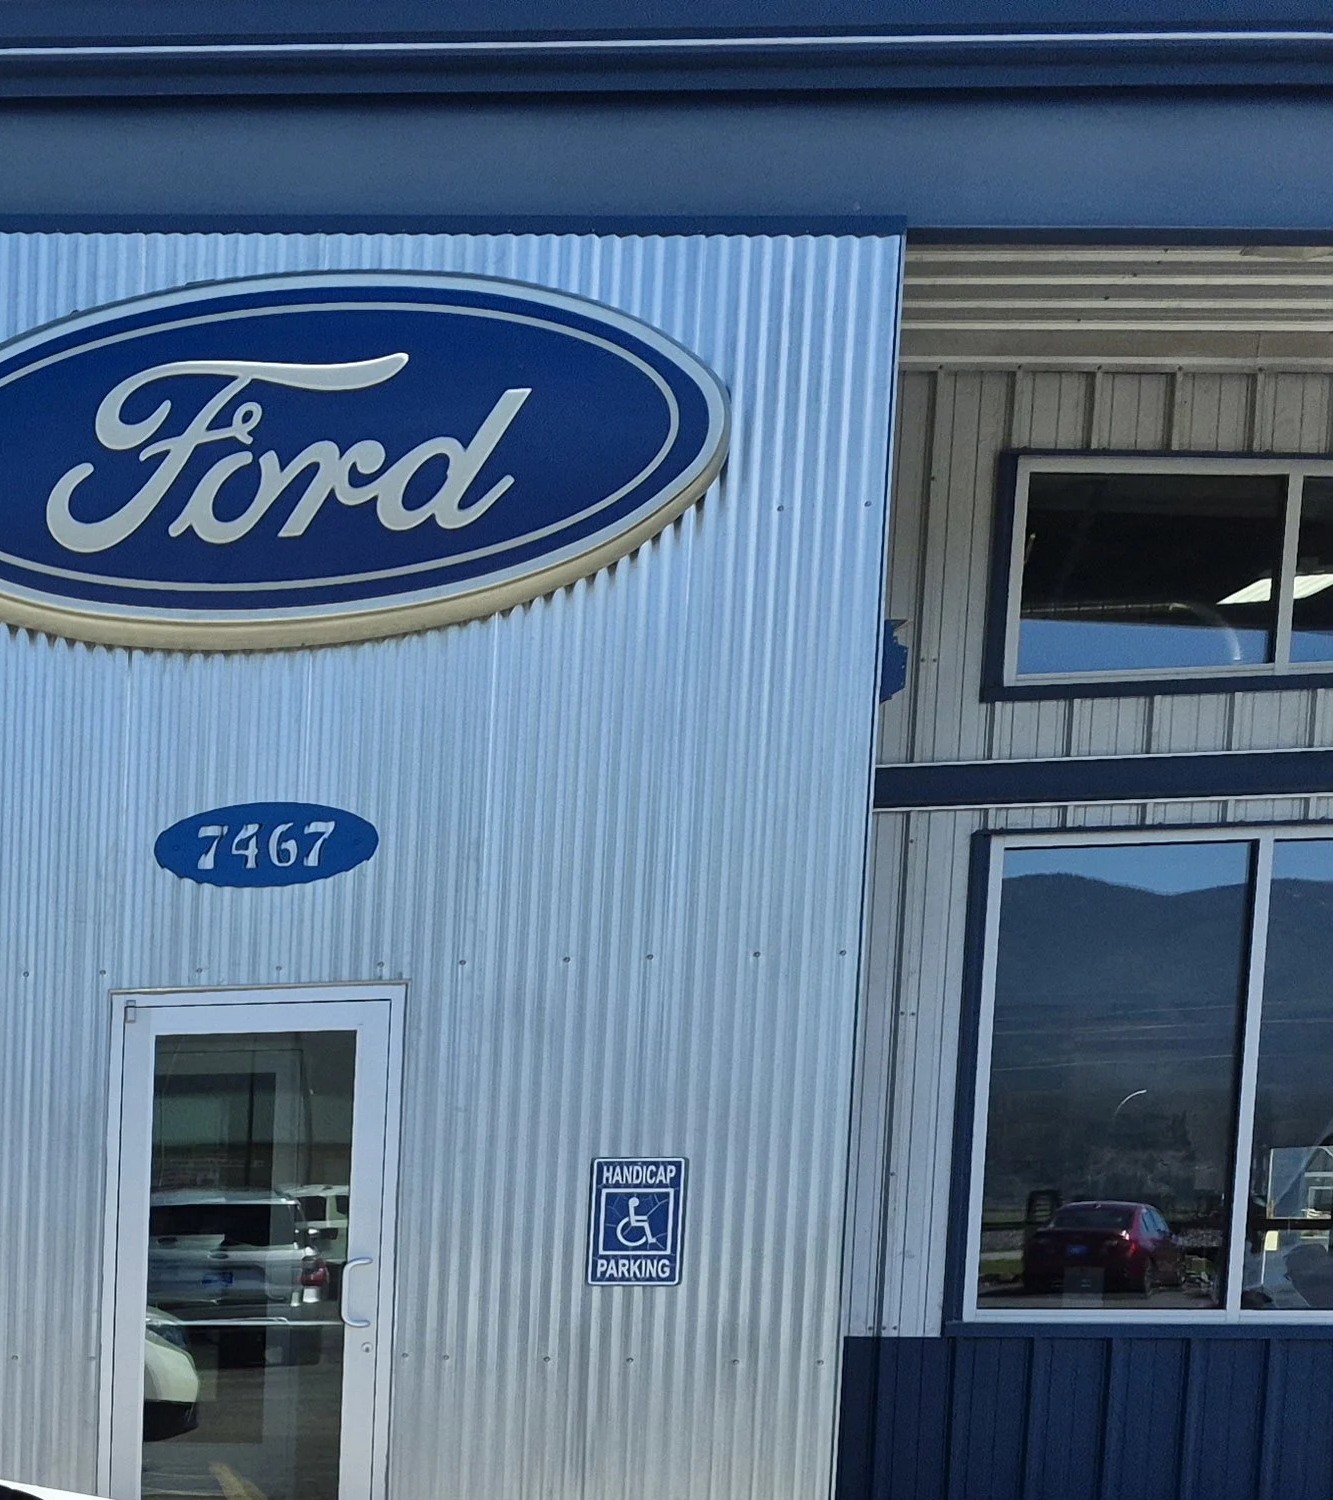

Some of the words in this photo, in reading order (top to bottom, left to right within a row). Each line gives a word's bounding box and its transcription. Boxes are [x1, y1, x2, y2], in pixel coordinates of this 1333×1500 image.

[46, 352, 532, 554] Ford
[196, 820, 336, 870] 7467
[602, 1164, 677, 1185] HANDICAP
[596, 1258, 671, 1279] PARKING
